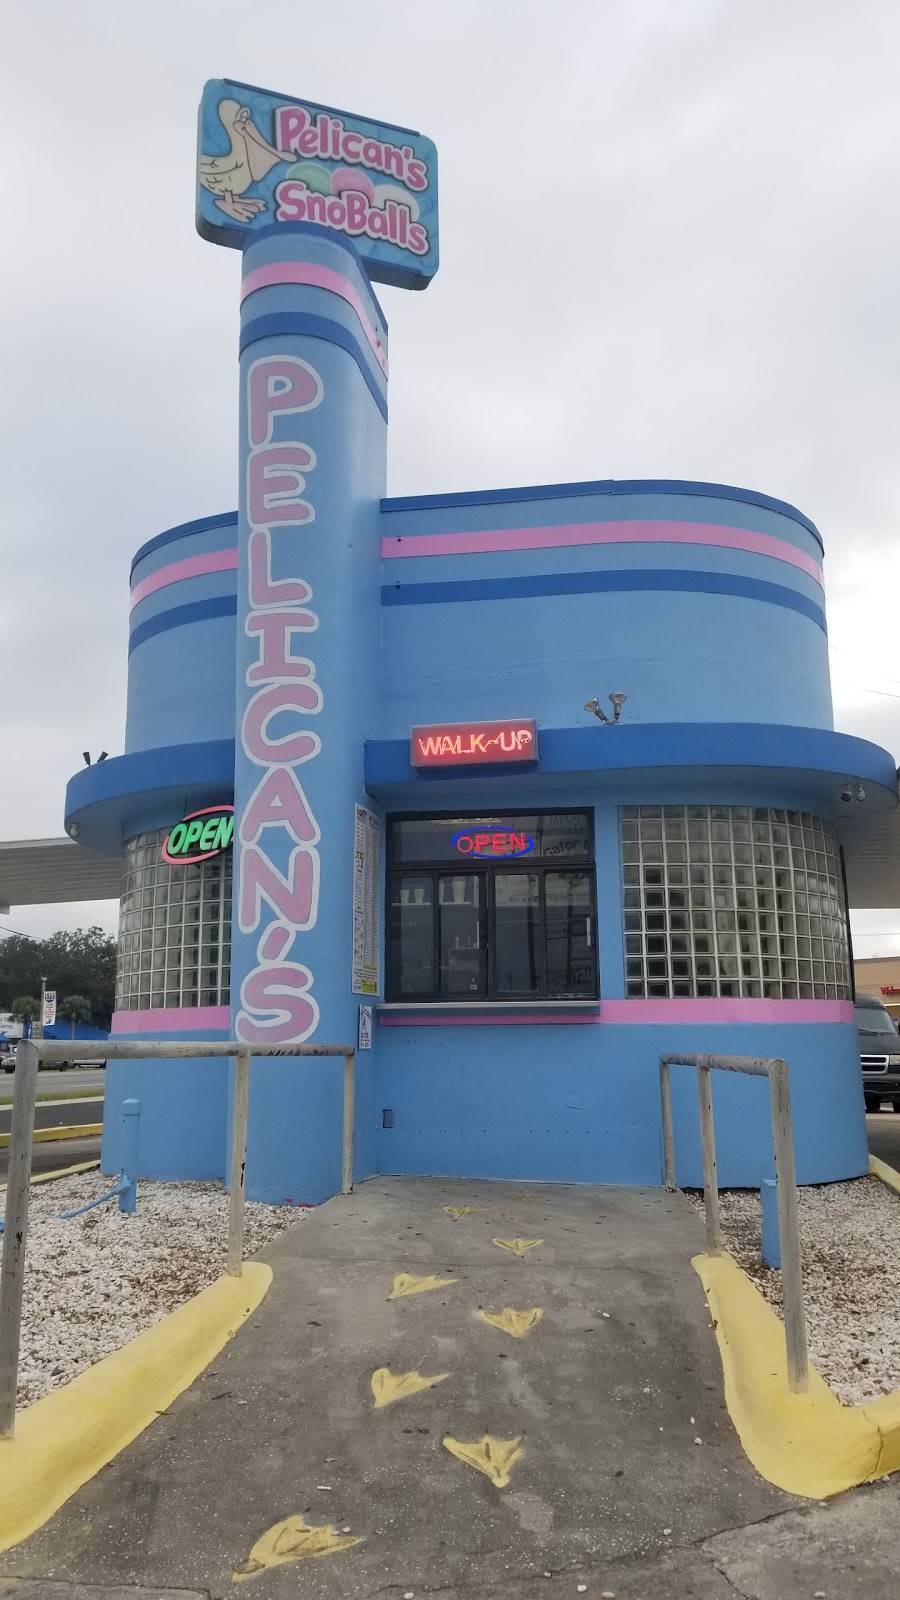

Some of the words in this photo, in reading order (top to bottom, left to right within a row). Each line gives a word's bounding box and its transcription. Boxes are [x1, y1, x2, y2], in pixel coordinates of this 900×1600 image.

[276, 105, 428, 191] Pelican's
[276, 181, 429, 254] SnoBalls
[237, 355, 324, 1043] PELICAN'S
[419, 729, 532, 756] WALK-UP
[167, 815, 234, 855] OPEN
[457, 832, 526, 852] OPEN
